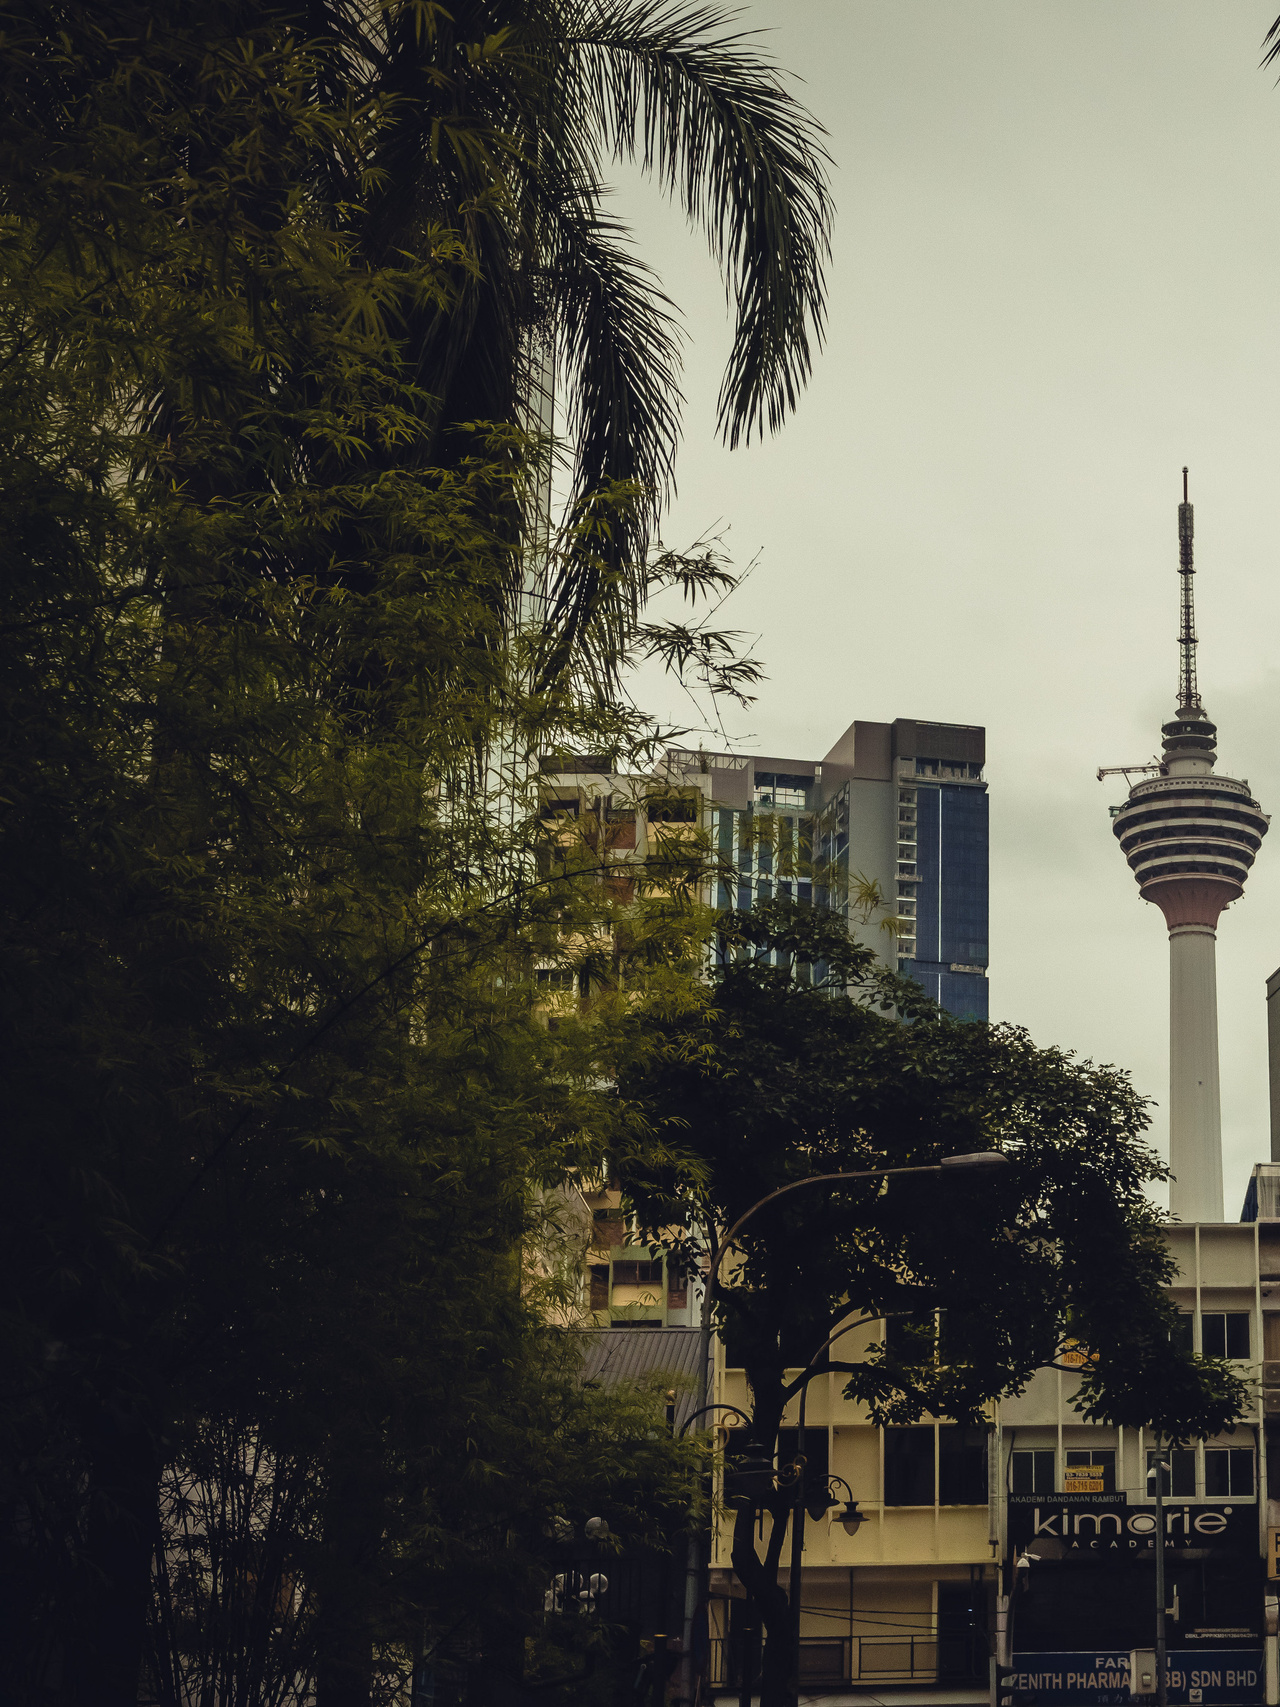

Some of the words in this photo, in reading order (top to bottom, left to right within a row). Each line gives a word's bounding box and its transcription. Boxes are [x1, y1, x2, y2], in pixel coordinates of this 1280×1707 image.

[1010, 1496, 1046, 1504] AKADEMI
[1046, 1495, 1091, 1503] DANDANAN
[1091, 1495, 1125, 1503] RAMBUT
[1033, 1506, 1228, 1537] kimorie
[1071, 1539, 1193, 1549] ACADEMY
[1095, 1657, 1172, 1669] FARI
[1013, 1673, 1063, 1690] ZENITH
[1190, 1671, 1222, 1688] SDN
[1226, 1669, 1258, 1687] BHD
